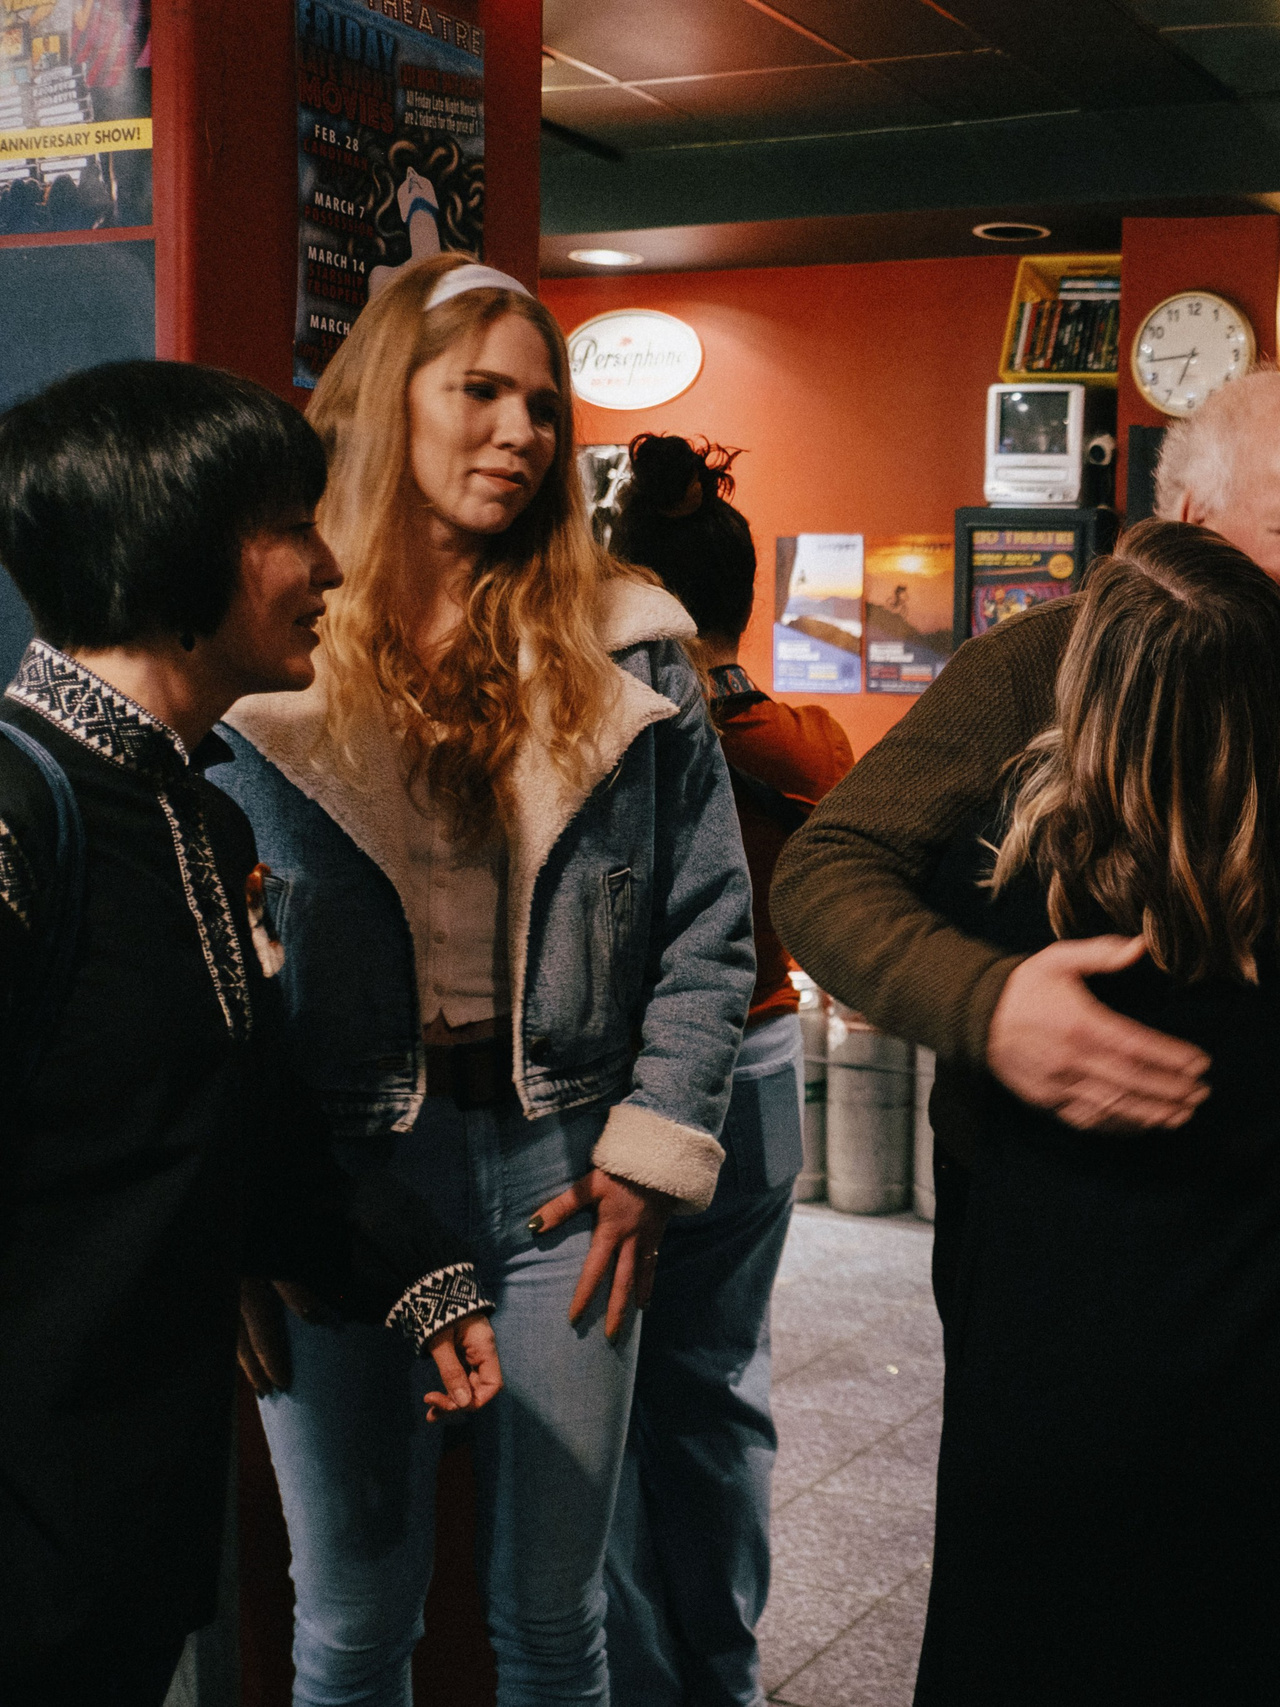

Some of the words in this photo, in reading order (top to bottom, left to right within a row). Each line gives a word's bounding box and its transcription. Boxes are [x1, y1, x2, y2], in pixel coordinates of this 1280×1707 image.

[298, 0, 396, 74] FRIDAY
[368, 0, 482, 55] HEATRE
[299, 69, 395, 133] MOVIES
[0, 131, 91, 152] ANNIVERSARY
[95, 127, 141, 144] SHOW!
[314, 124, 341, 146] FEB.
[345, 135, 359, 152] 28
[314, 191, 355, 217] MARCH
[359, 206, 365, 219] 7
[304, 204, 374, 238] POSSESSION
[307, 245, 348, 269] MARCH
[352, 258, 365, 274] 14
[1166, 308, 1180, 321] 11
[1187, 302, 1202, 316] 12
[1213, 308, 1219, 321] 1
[309, 314, 351, 336] MARCH
[1147, 326, 1165, 340] 10
[569, 335, 686, 386] Persephone
